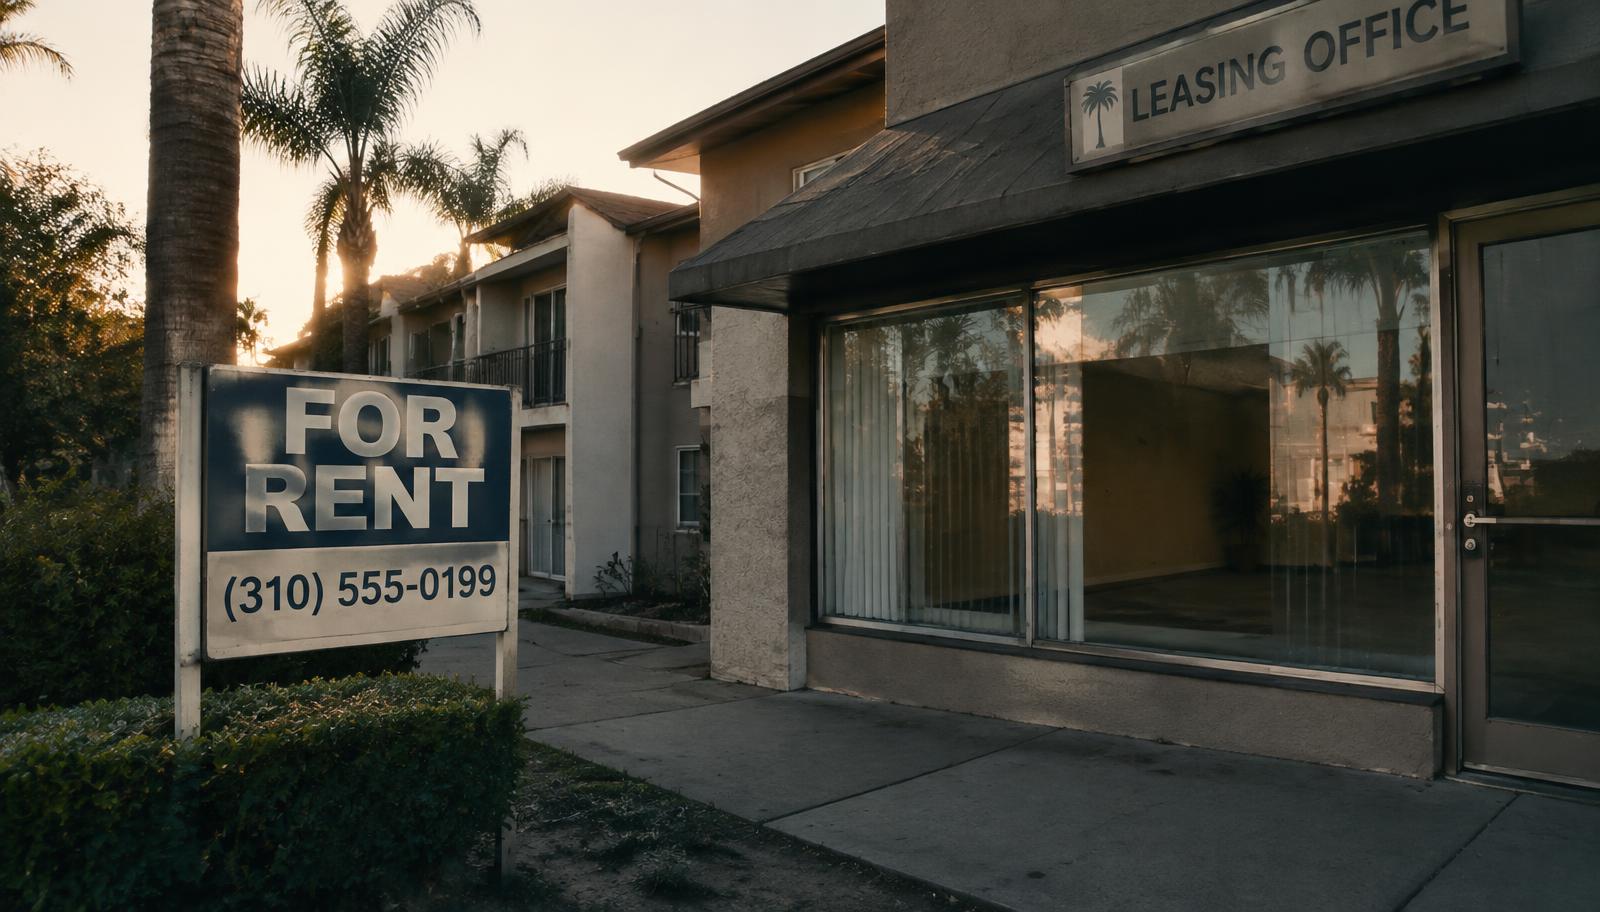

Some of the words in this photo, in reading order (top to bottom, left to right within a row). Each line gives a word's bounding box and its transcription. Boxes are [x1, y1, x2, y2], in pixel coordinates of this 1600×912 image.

[1131, 45, 1286, 122] LEASING
[1303, 0, 1469, 73] OFFICE
[286, 387, 459, 459] FOR
[245, 463, 485, 533] RENT
[224, 572, 324, 622] (310)
[338, 564, 497, 607] 555-0199
